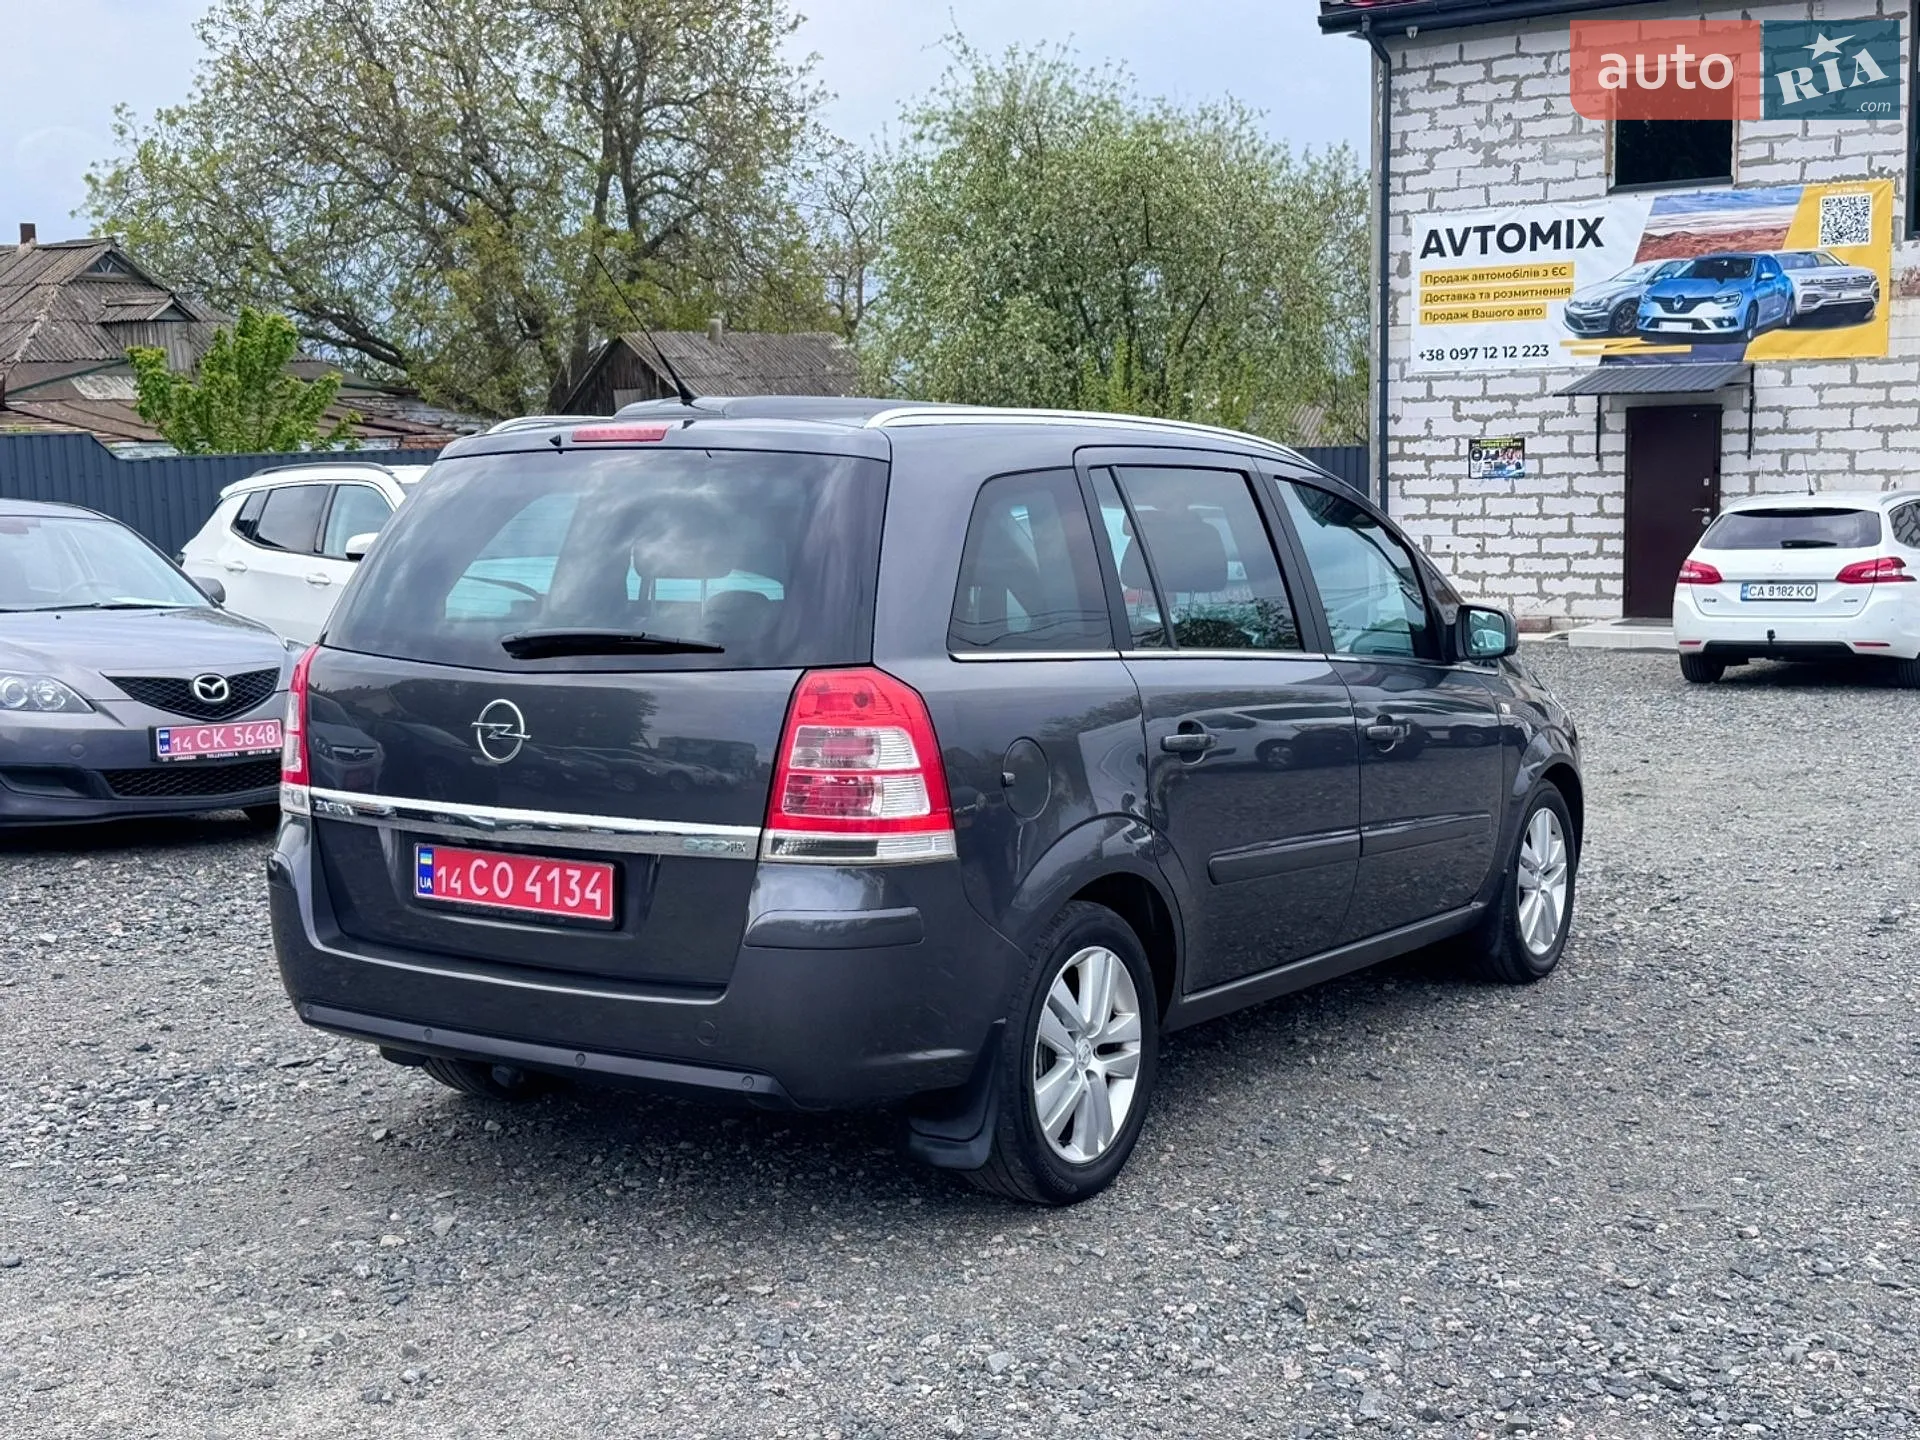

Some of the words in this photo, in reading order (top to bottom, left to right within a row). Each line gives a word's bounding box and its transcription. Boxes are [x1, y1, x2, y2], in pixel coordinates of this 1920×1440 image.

[1420, 217, 1604, 259] AVTOMIX
[1424, 274, 1470, 286] Продаж
[1471, 268, 1540, 281] автомобілів
[1551, 266, 1568, 277] ЄС
[1424, 292, 1476, 304] Доставка
[1478, 292, 1490, 300] та
[1493, 286, 1571, 301] розмитнення
[1424, 311, 1469, 323] Продаж
[1471, 308, 1515, 320] Вашого
[1517, 308, 1543, 317] авто
[1418, 349, 1445, 361] +38
[1450, 348, 1478, 361] 097
[1483, 347, 1498, 359] 12
[1502, 346, 1518, 358] 12
[1522, 344, 1550, 357] 223
[1749, 586, 1765, 597] CA
[1768, 586, 1795, 597] 8182
[1796, 586, 1814, 597] KO
[172, 736, 192, 751] 14
[197, 728, 227, 748] CK
[234, 724, 276, 746] 5648
[419, 877, 433, 890] UA
[436, 866, 462, 895] 14
[469, 858, 514, 899] CO
[524, 865, 602, 911] 4134
